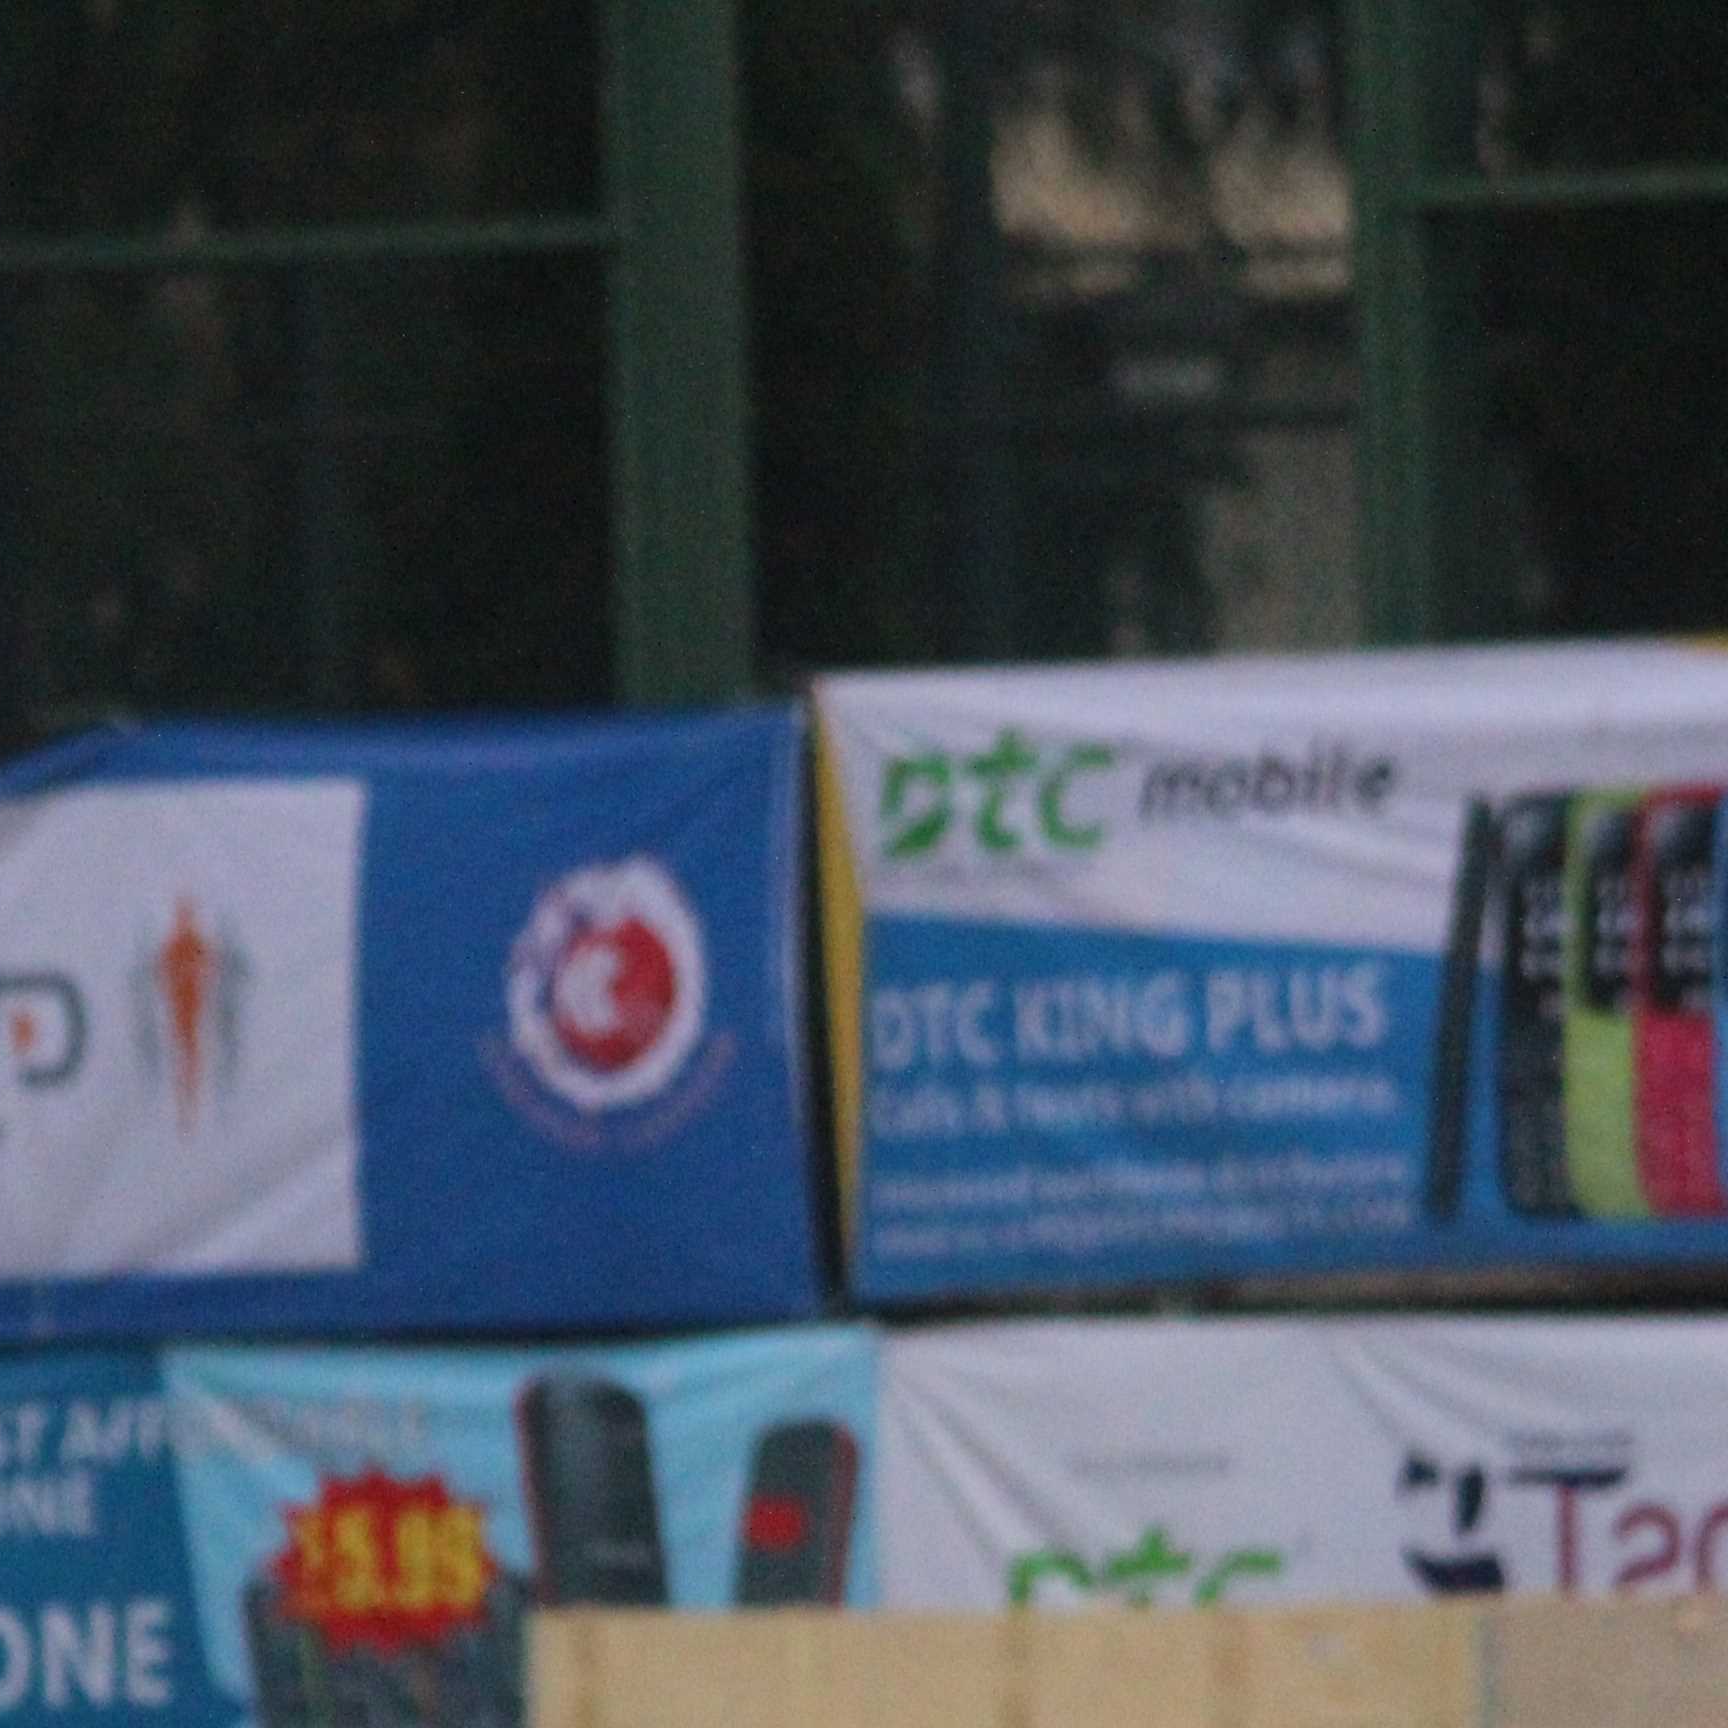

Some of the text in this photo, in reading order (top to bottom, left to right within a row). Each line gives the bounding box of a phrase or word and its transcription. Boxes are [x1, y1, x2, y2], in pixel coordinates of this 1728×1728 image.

[1138, 735, 1399, 820] mobile
[1014, 968, 1188, 1062] KING
[1204, 960, 1388, 1052] PLUS
